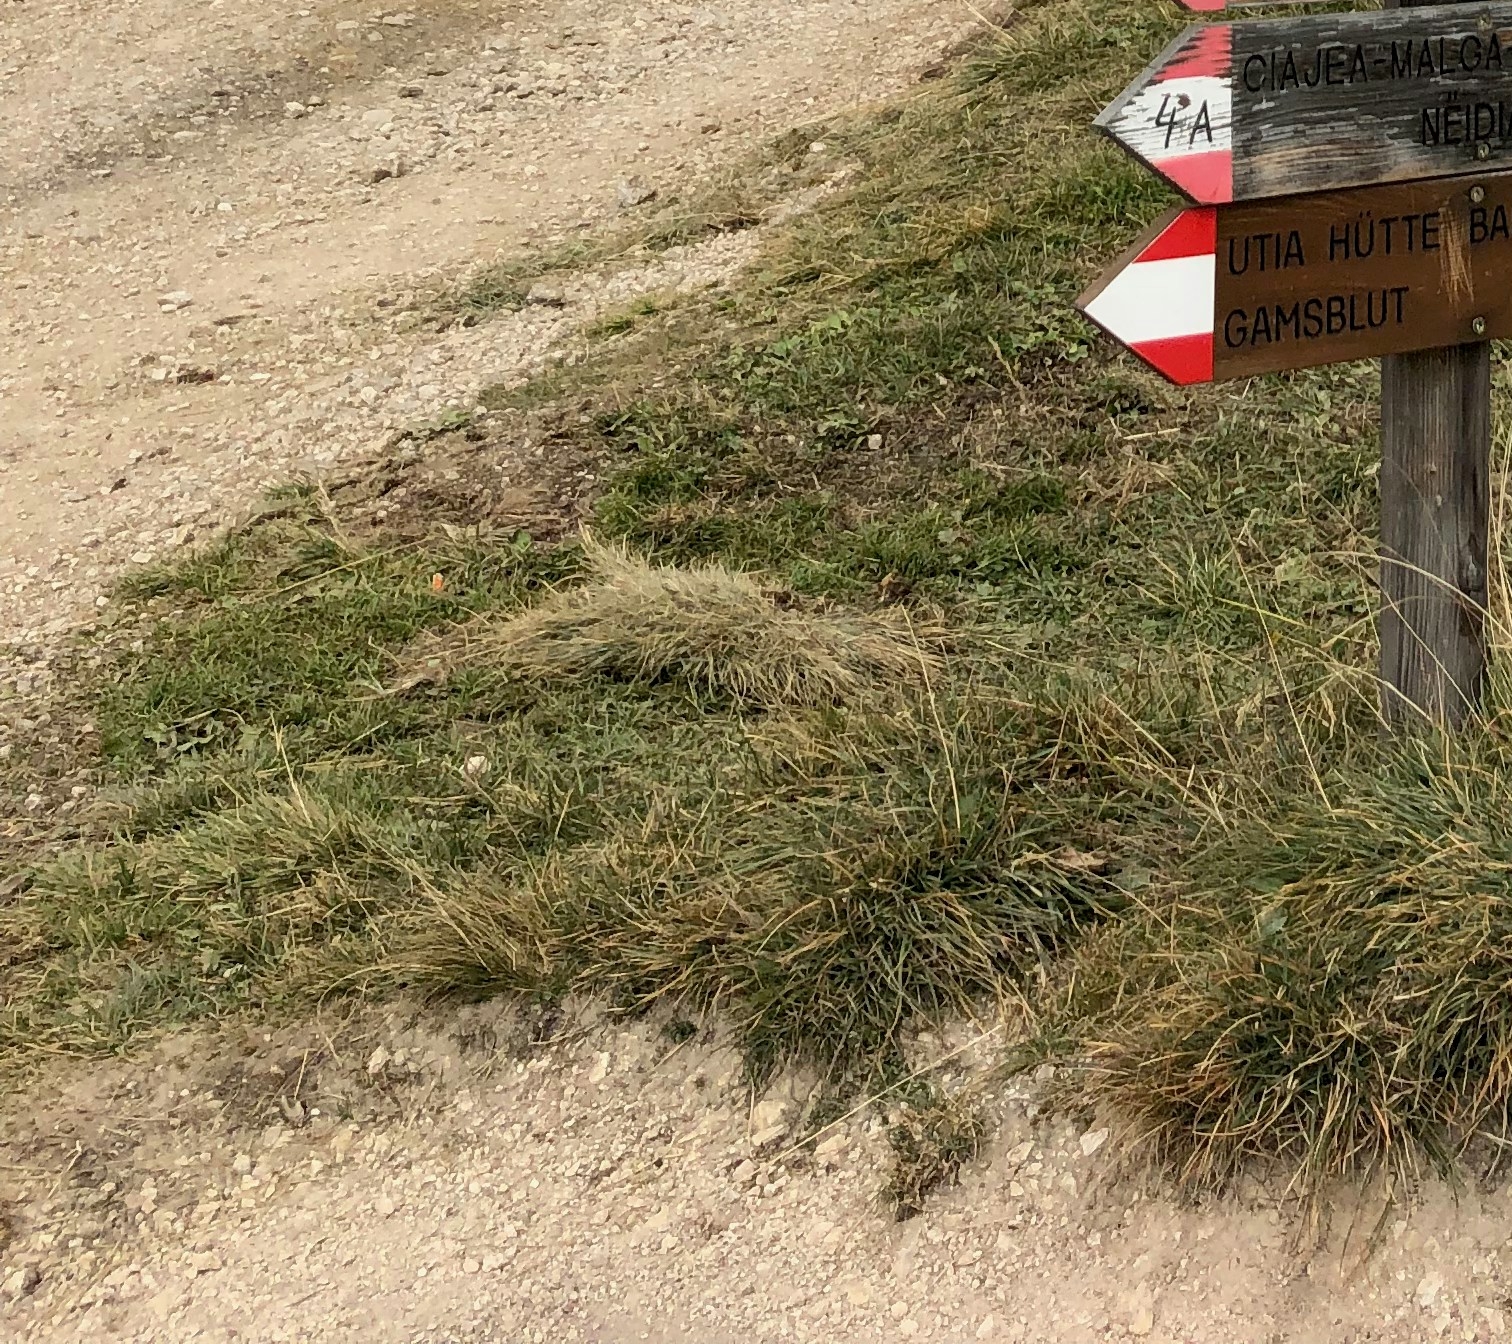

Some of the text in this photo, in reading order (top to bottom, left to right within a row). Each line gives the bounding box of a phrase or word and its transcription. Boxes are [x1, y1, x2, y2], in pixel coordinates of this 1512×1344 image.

[1227, 231, 1302, 275] UTIA
[1328, 208, 1440, 261] HÜTTE
[1224, 287, 1410, 348] GAMSBLUT
